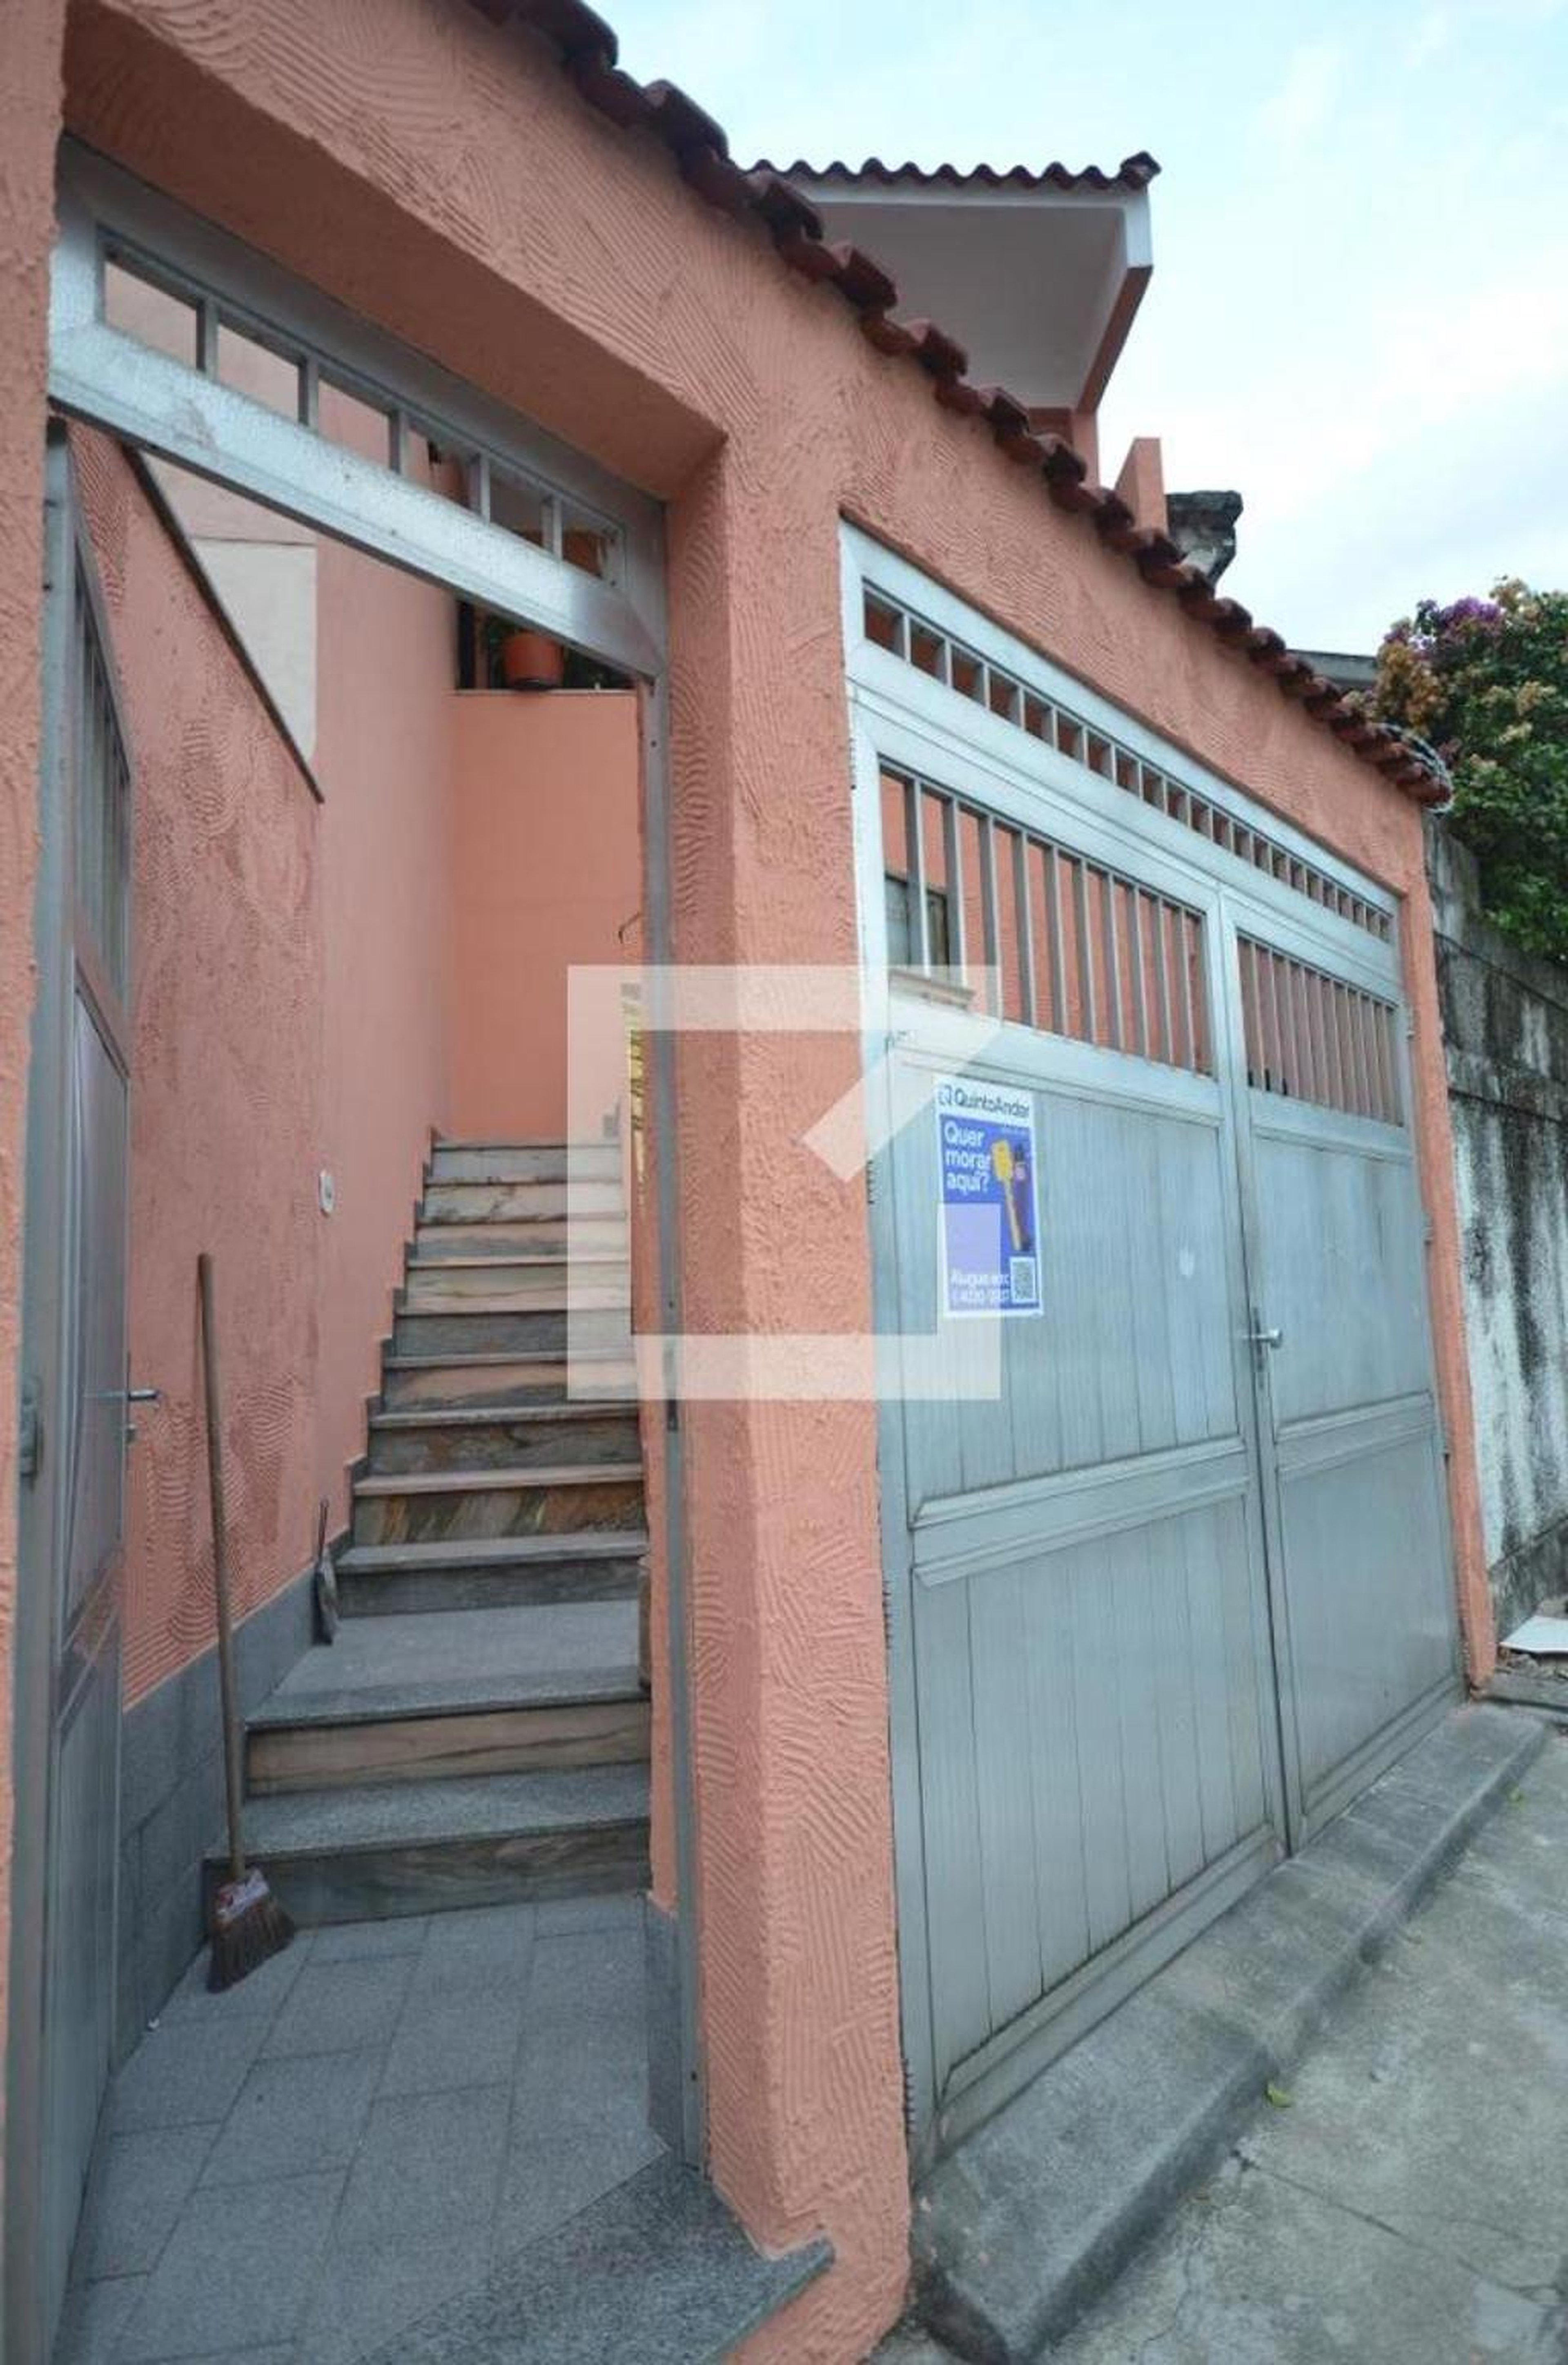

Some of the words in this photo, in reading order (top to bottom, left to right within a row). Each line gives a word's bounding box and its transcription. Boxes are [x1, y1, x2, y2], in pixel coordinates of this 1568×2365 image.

[944, 1121, 984, 1147] Quer
[947, 1151, 990, 1170] morar
[947, 1170, 990, 1196] aqui?
